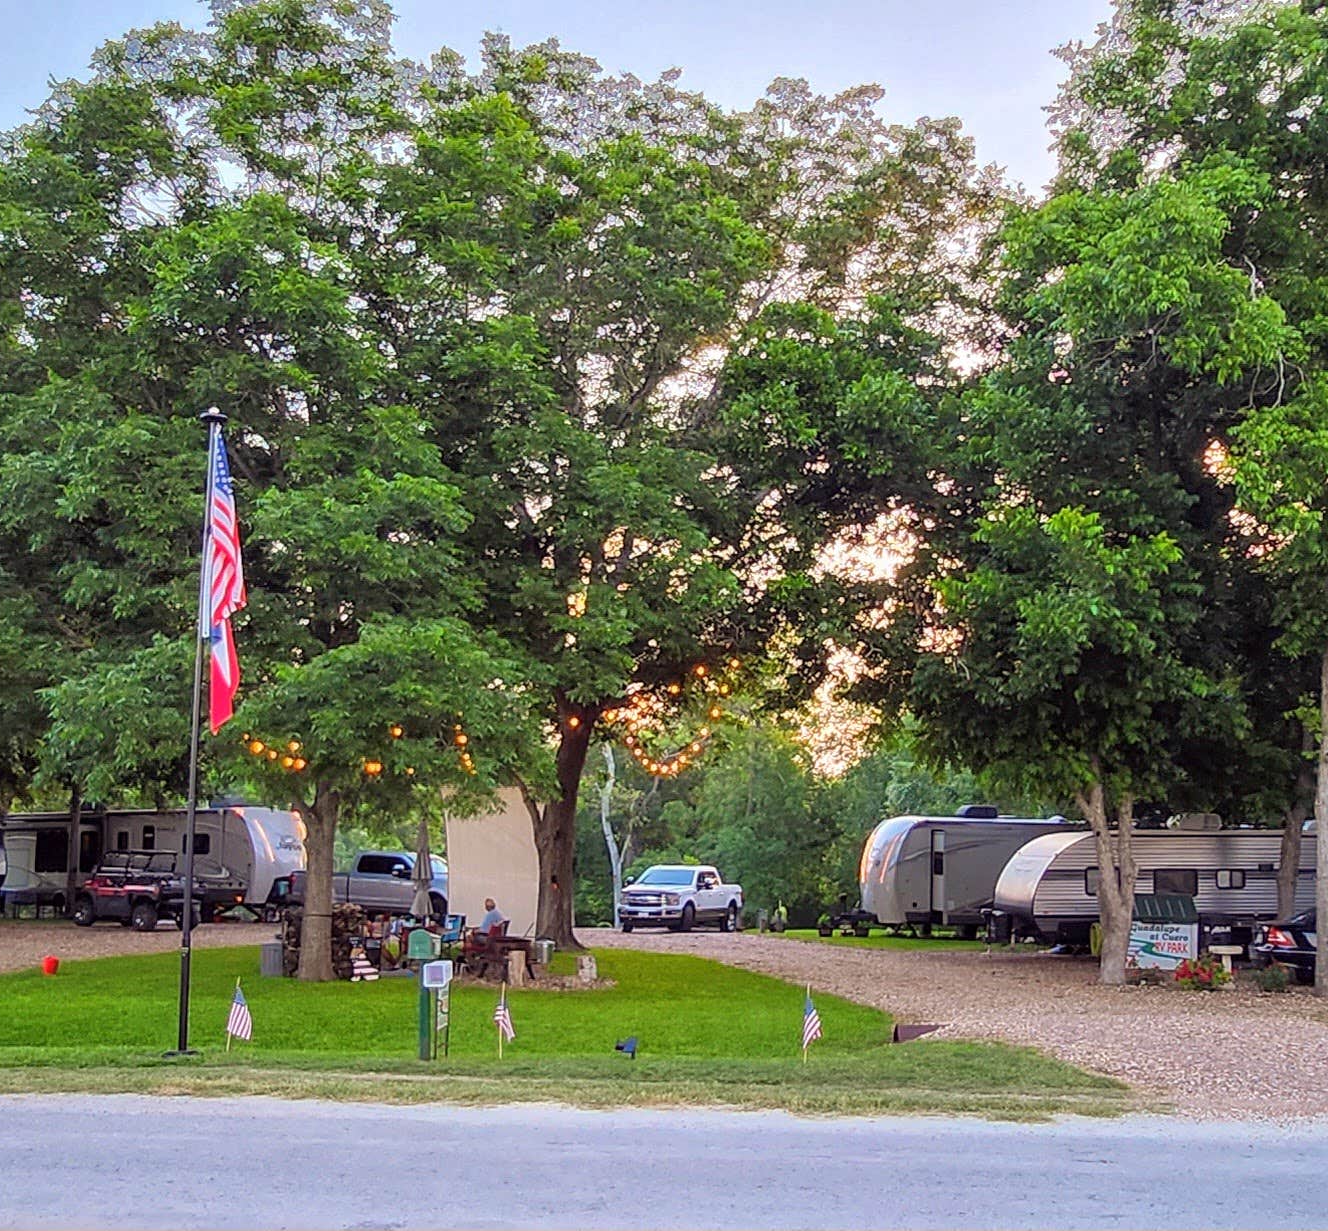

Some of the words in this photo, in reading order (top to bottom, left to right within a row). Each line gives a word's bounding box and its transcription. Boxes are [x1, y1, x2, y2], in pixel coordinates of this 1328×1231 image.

[1162, 933, 1189, 941] Cuero
[1155, 942, 1166, 951] RV
[1167, 942, 1188, 953] PARK
